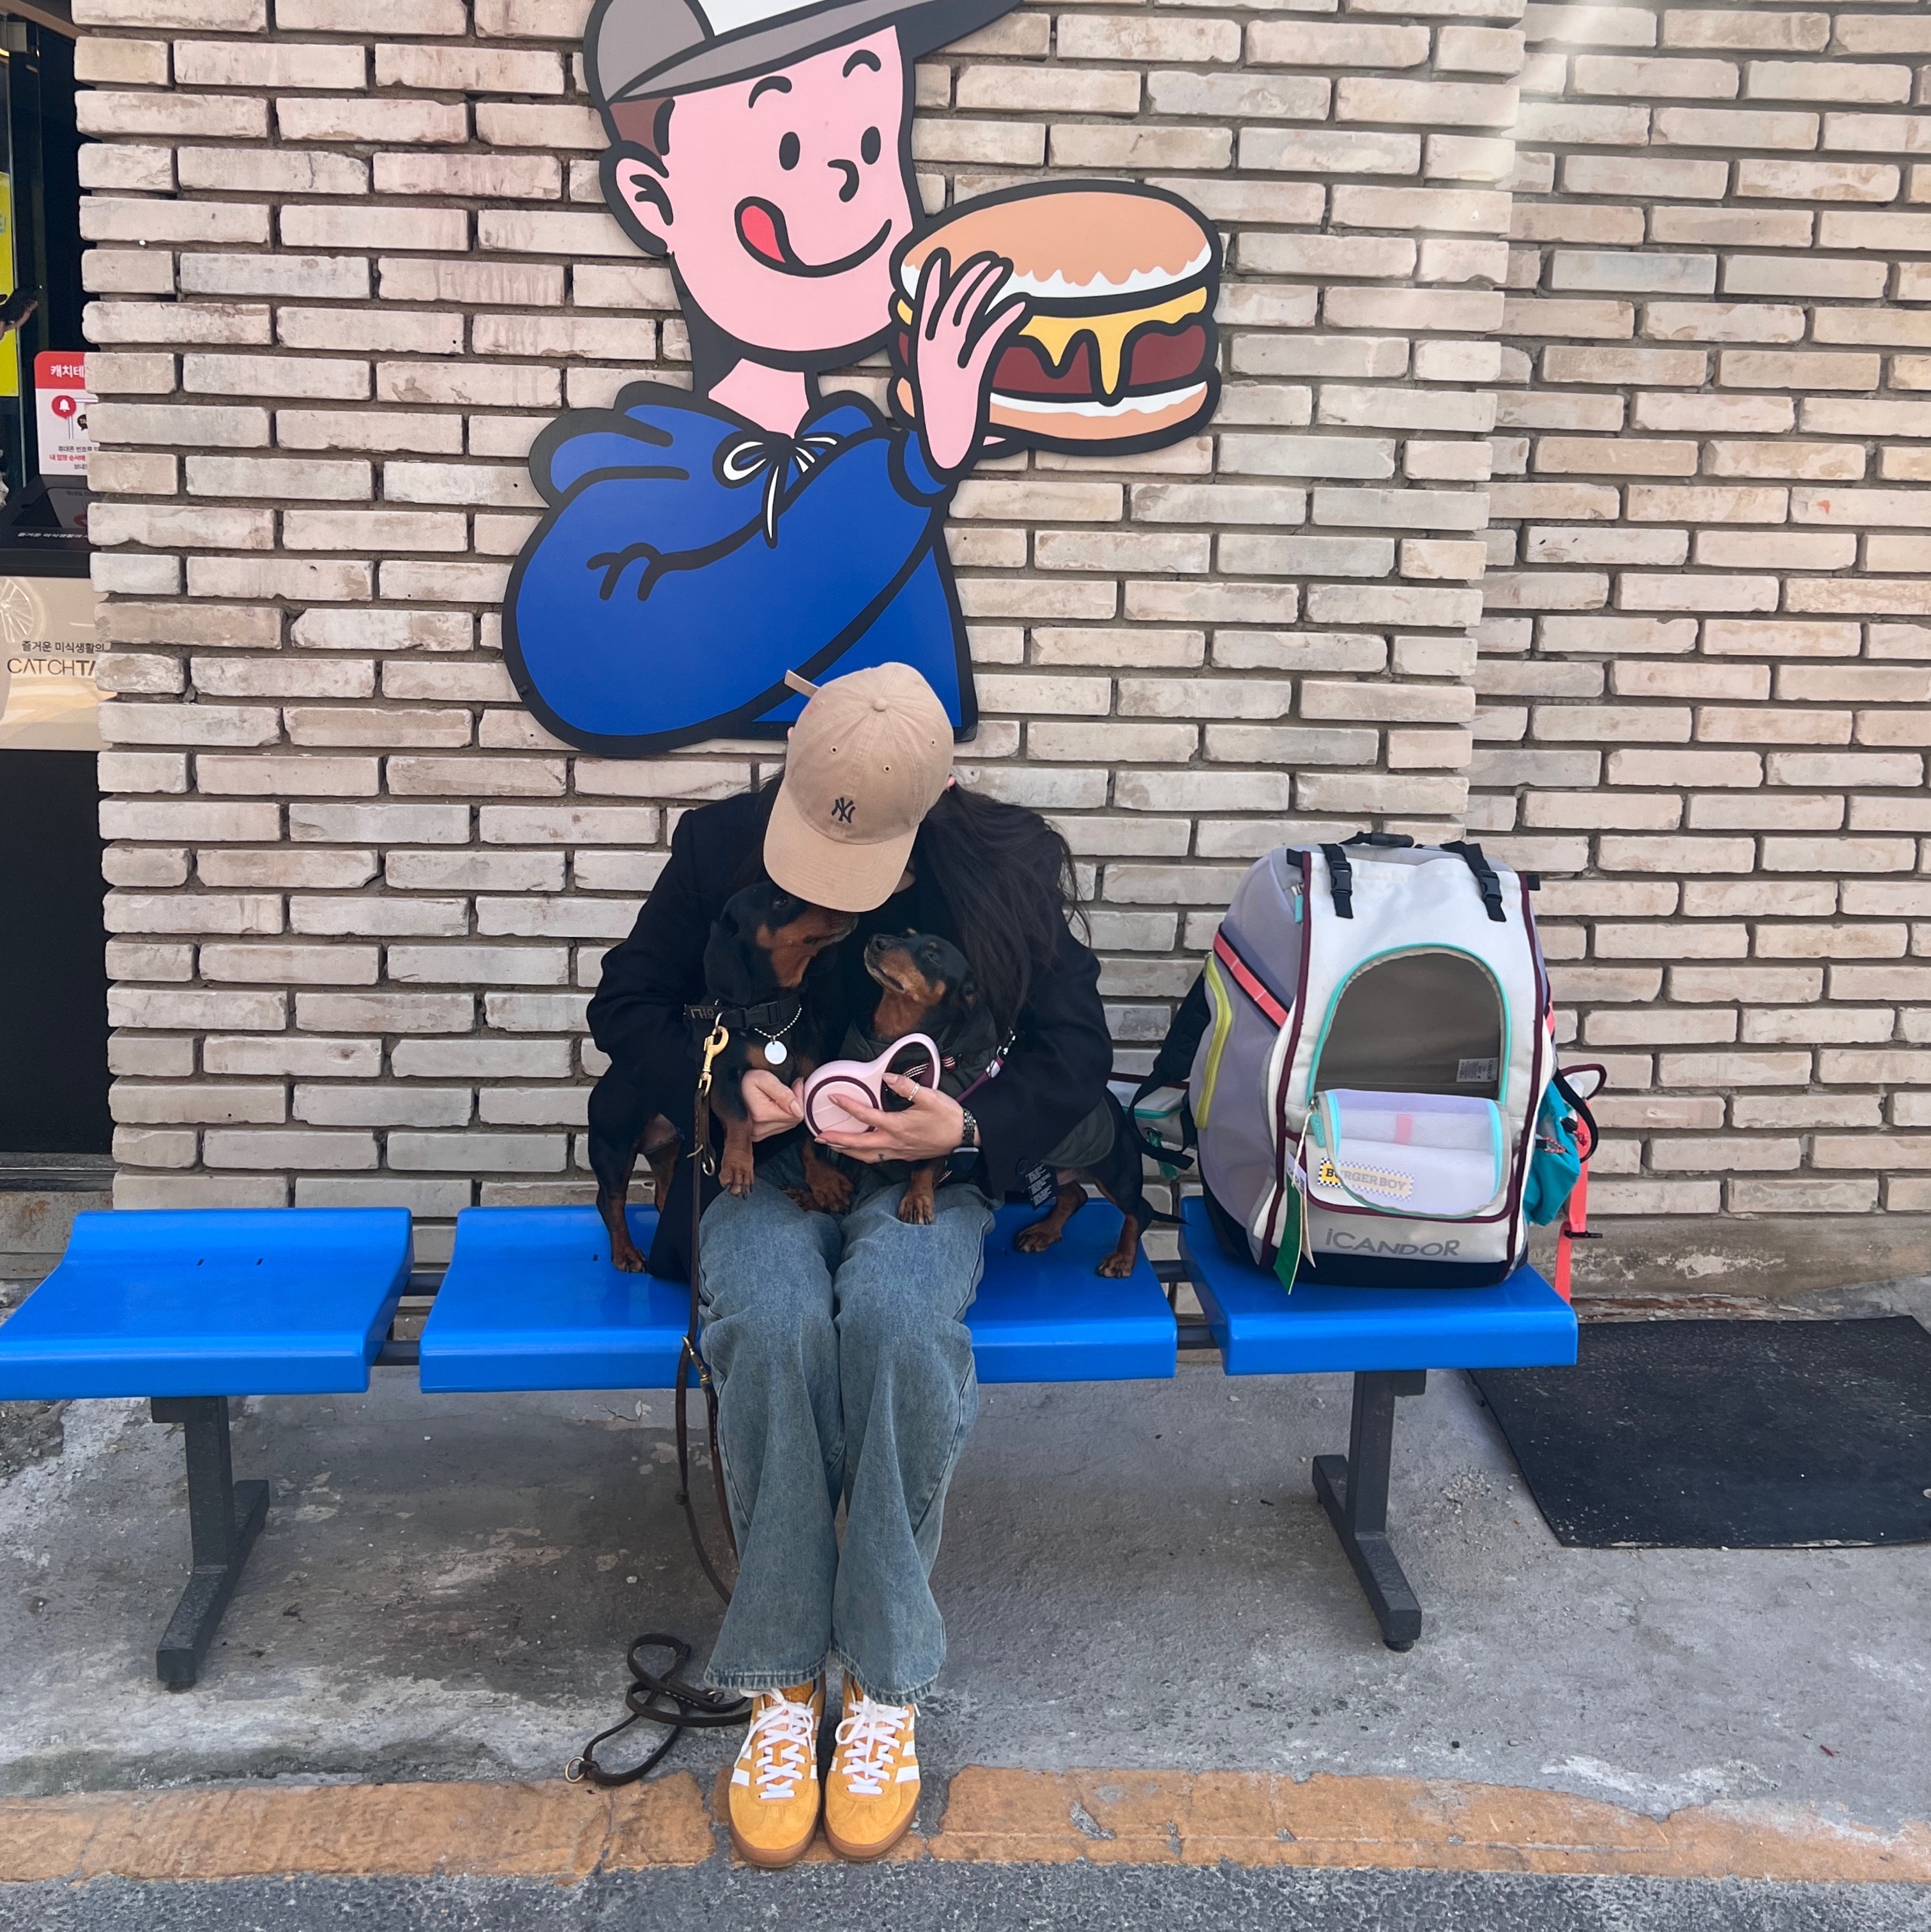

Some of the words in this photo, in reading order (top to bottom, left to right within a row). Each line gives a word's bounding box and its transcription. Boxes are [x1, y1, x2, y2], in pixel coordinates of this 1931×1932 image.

[50, 365, 84, 378] 캐치테
[22, 641, 52, 652] 즐거운
[55, 642, 104, 653] 미식생활의
[831, 797, 856, 823] NY
